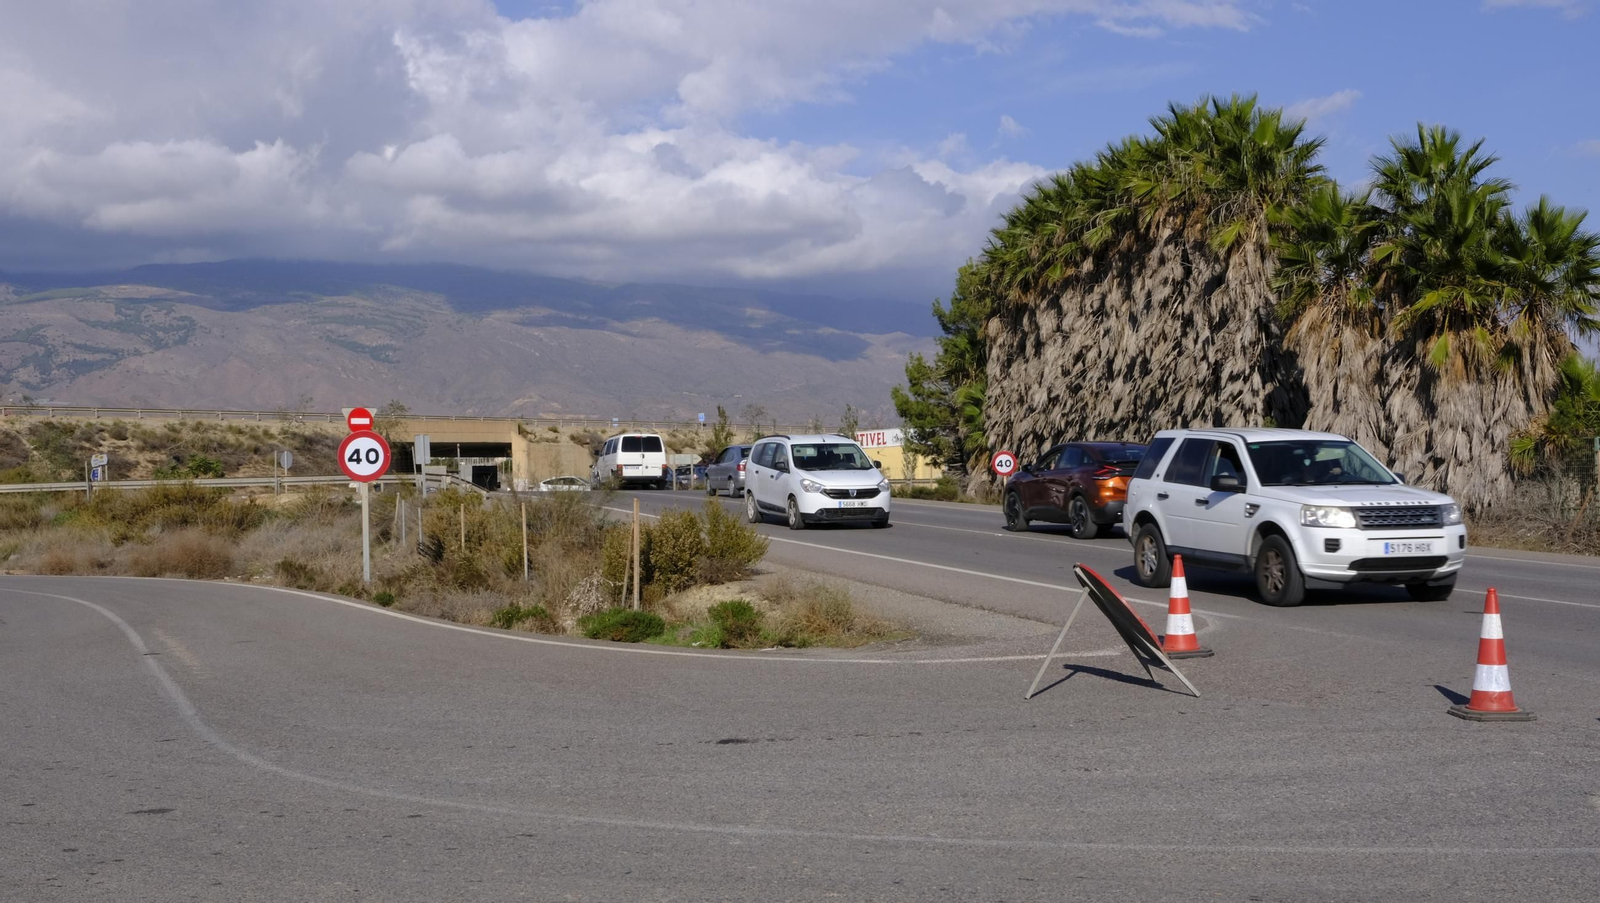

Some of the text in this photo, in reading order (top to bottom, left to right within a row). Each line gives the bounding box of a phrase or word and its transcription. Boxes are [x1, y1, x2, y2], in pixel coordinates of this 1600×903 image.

[347, 448, 379, 465] 40
[997, 459, 1012, 468] 40
[1390, 542, 1432, 553] 5176 HGX
